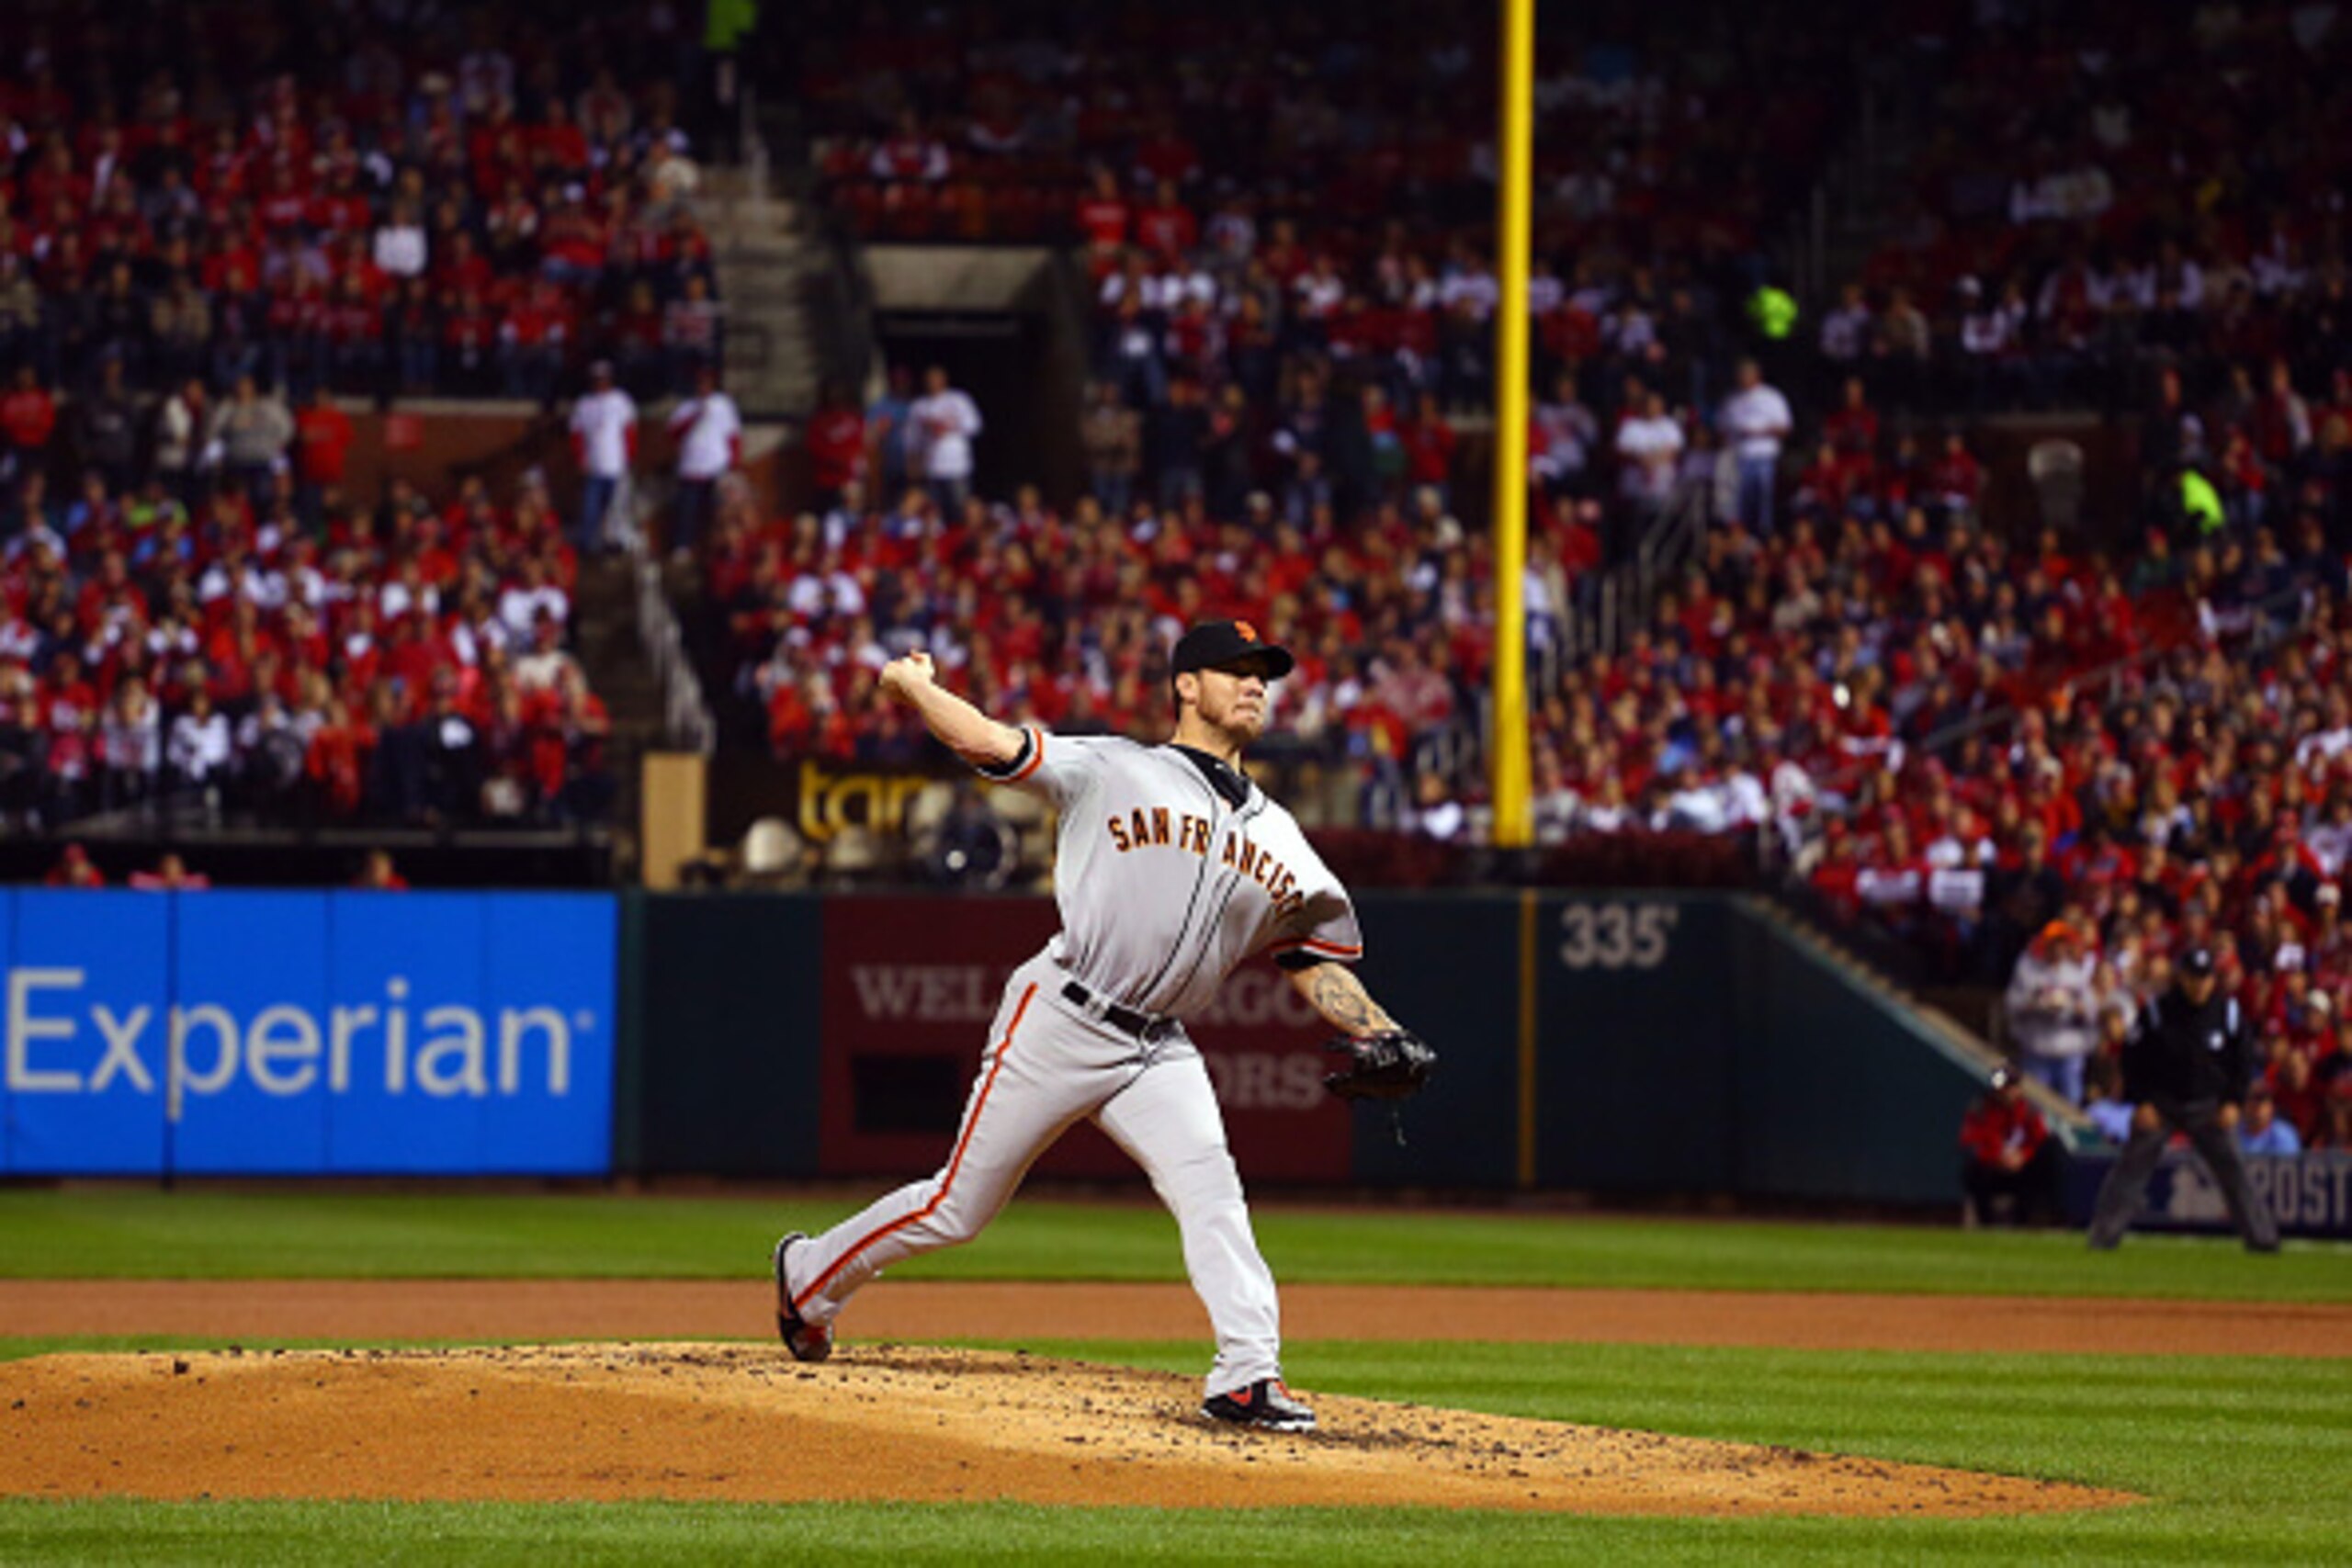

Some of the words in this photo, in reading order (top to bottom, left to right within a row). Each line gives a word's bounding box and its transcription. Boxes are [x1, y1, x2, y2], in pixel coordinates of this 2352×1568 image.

[1107, 807, 1170, 853] SAN
[849, 964, 1005, 1022] WEL
[5, 966, 571, 1122] Experian
